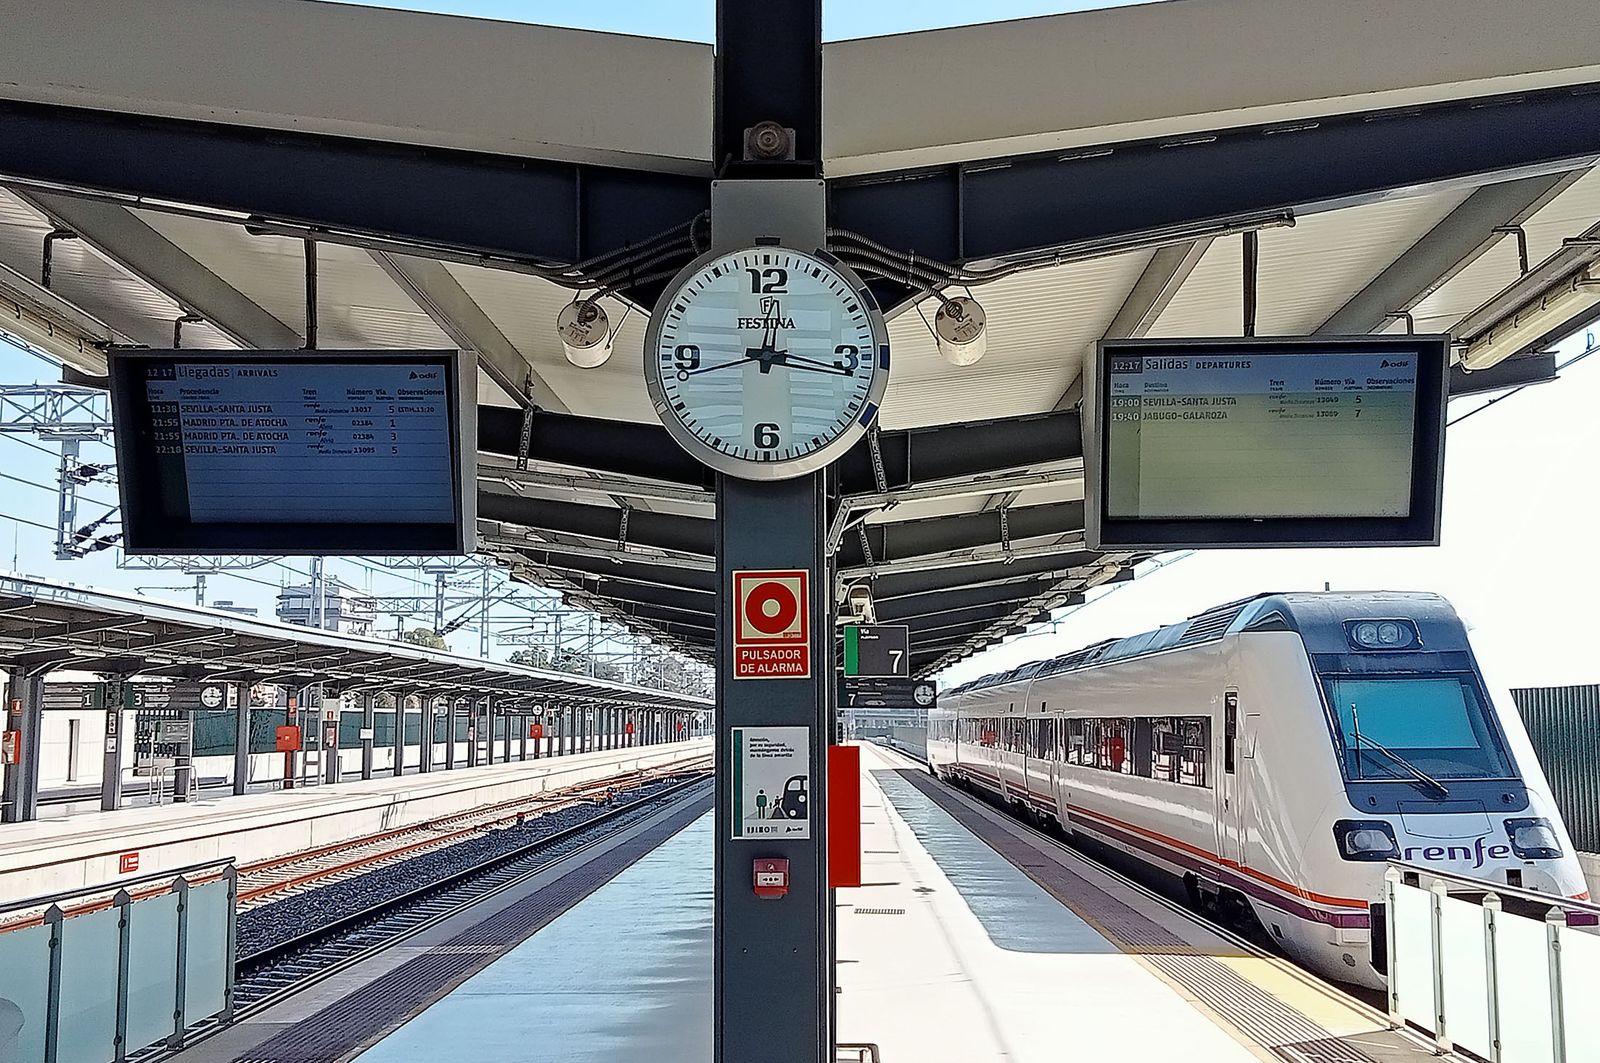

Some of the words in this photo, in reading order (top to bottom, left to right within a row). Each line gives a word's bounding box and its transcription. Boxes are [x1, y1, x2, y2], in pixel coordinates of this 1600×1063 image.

[746, 269, 788, 294] 12
[737, 317, 796, 329] FESTINA
[675, 345, 700, 370] 9
[834, 345, 859, 370] 3
[1113, 361, 1140, 370] 12:17
[1145, 358, 1188, 370] Salidas
[1195, 360, 1252, 369] DEPARTURES
[179, 366, 230, 379] Llegadas
[237, 369, 278, 377] ARRIVALS
[1112, 398, 1140, 407] 19:00
[1143, 397, 1209, 406] SEVILLA-SANTA
[1211, 397, 1237, 406] JUSTA
[181, 404, 246, 413] SEVILLA-SANTA
[247, 404, 273, 413] JUSTA
[1143, 411, 1228, 420] JABUGO-GALAROZA
[152, 418, 179, 427] 21:55
[183, 418, 217, 427] MADRID
[220, 418, 239, 427] PTA.
[241, 418, 253, 427] DE
[255, 418, 288, 427] ATOCHA
[184, 432, 218, 441] MADRID
[221, 432, 240, 441] PTA.
[243, 432, 254, 441] DE
[256, 432, 289, 441] ATOCHA
[754, 423, 780, 449] 6
[185, 445, 249, 454] SEVILLA-SANTA
[252, 445, 277, 454] JUSTA
[742, 650, 801, 660] PULSADOR
[889, 650, 903, 673] 7
[740, 663, 755, 673] DE
[757, 663, 803, 673] ALARMA
[134, 693, 142, 706] 3
[848, 694, 856, 706] 7
[1404, 837, 1510, 869] renfe
